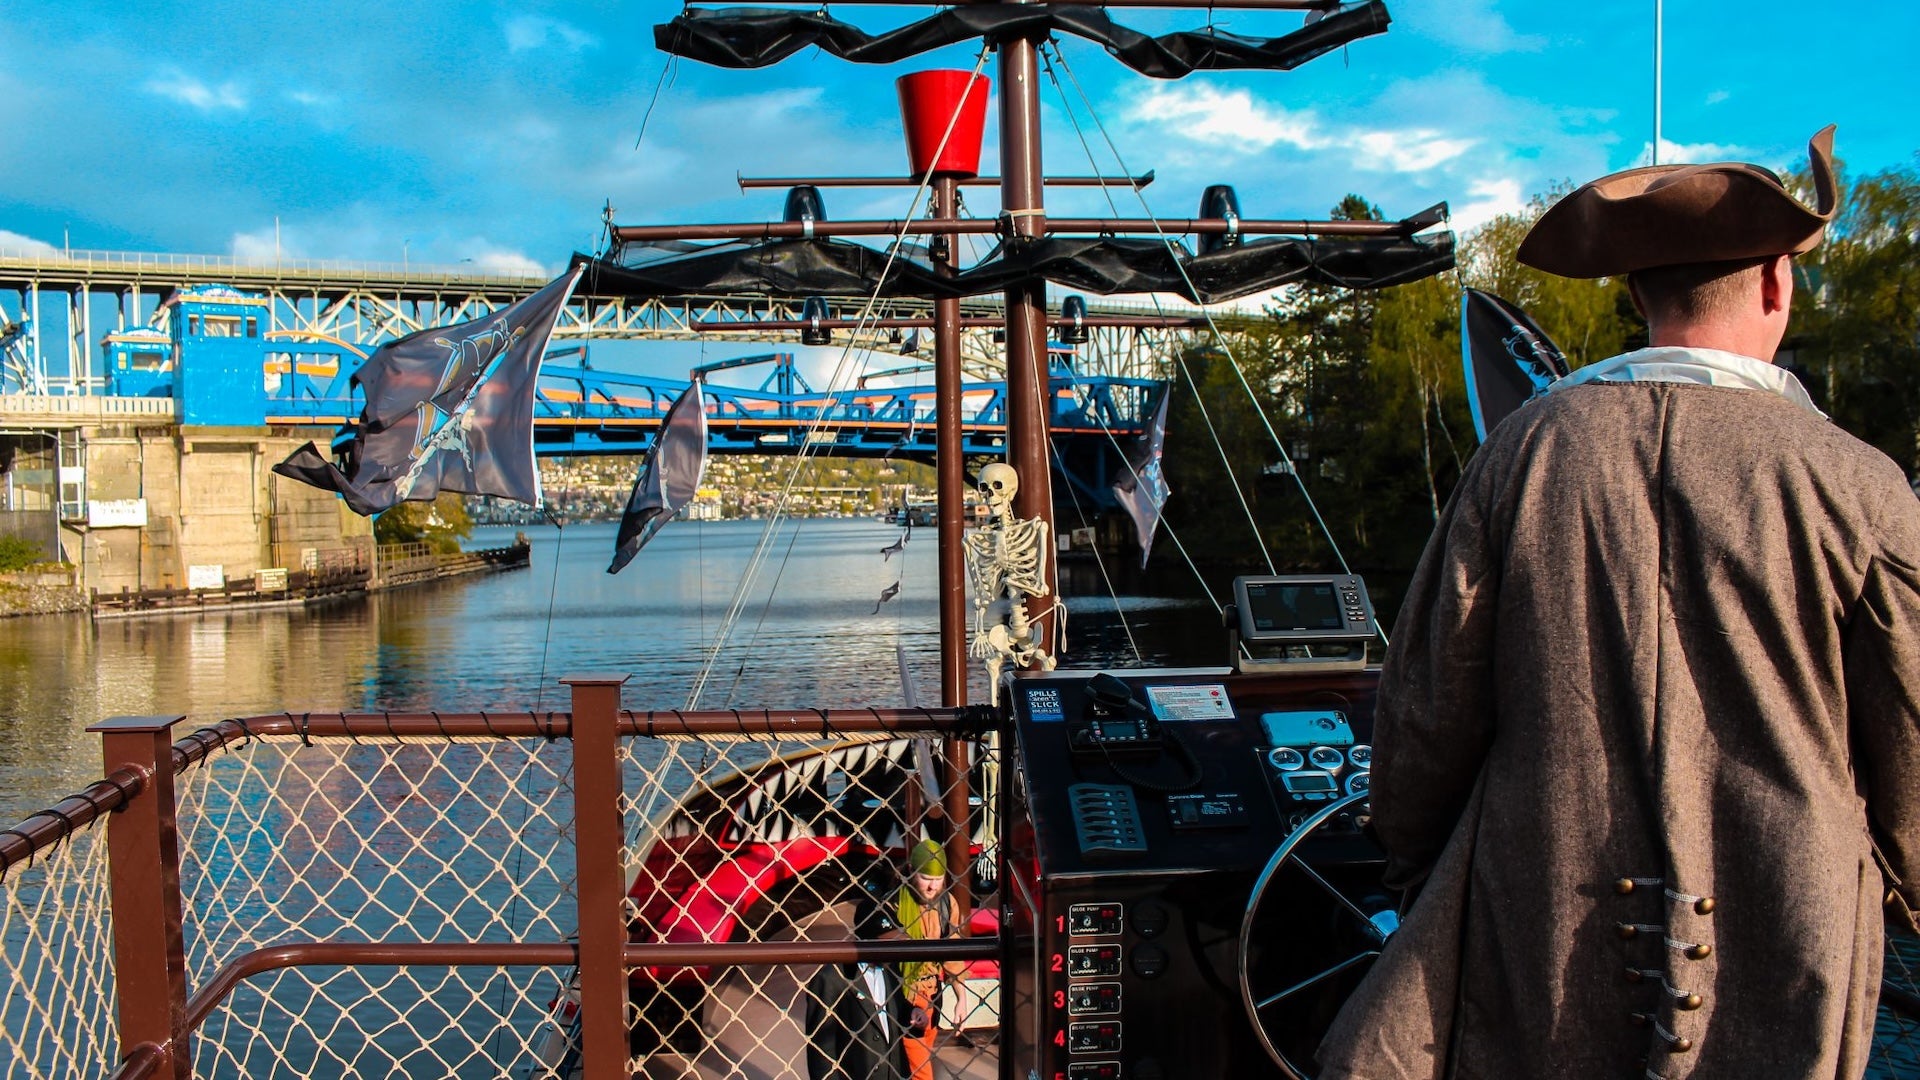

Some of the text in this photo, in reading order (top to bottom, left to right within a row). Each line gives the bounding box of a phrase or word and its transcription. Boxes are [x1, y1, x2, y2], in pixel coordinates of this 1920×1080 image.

[1056, 915, 1064, 933] 1
[1051, 953, 1063, 972] 2
[1054, 990, 1065, 1008] 3
[1054, 1029, 1065, 1047] 4
